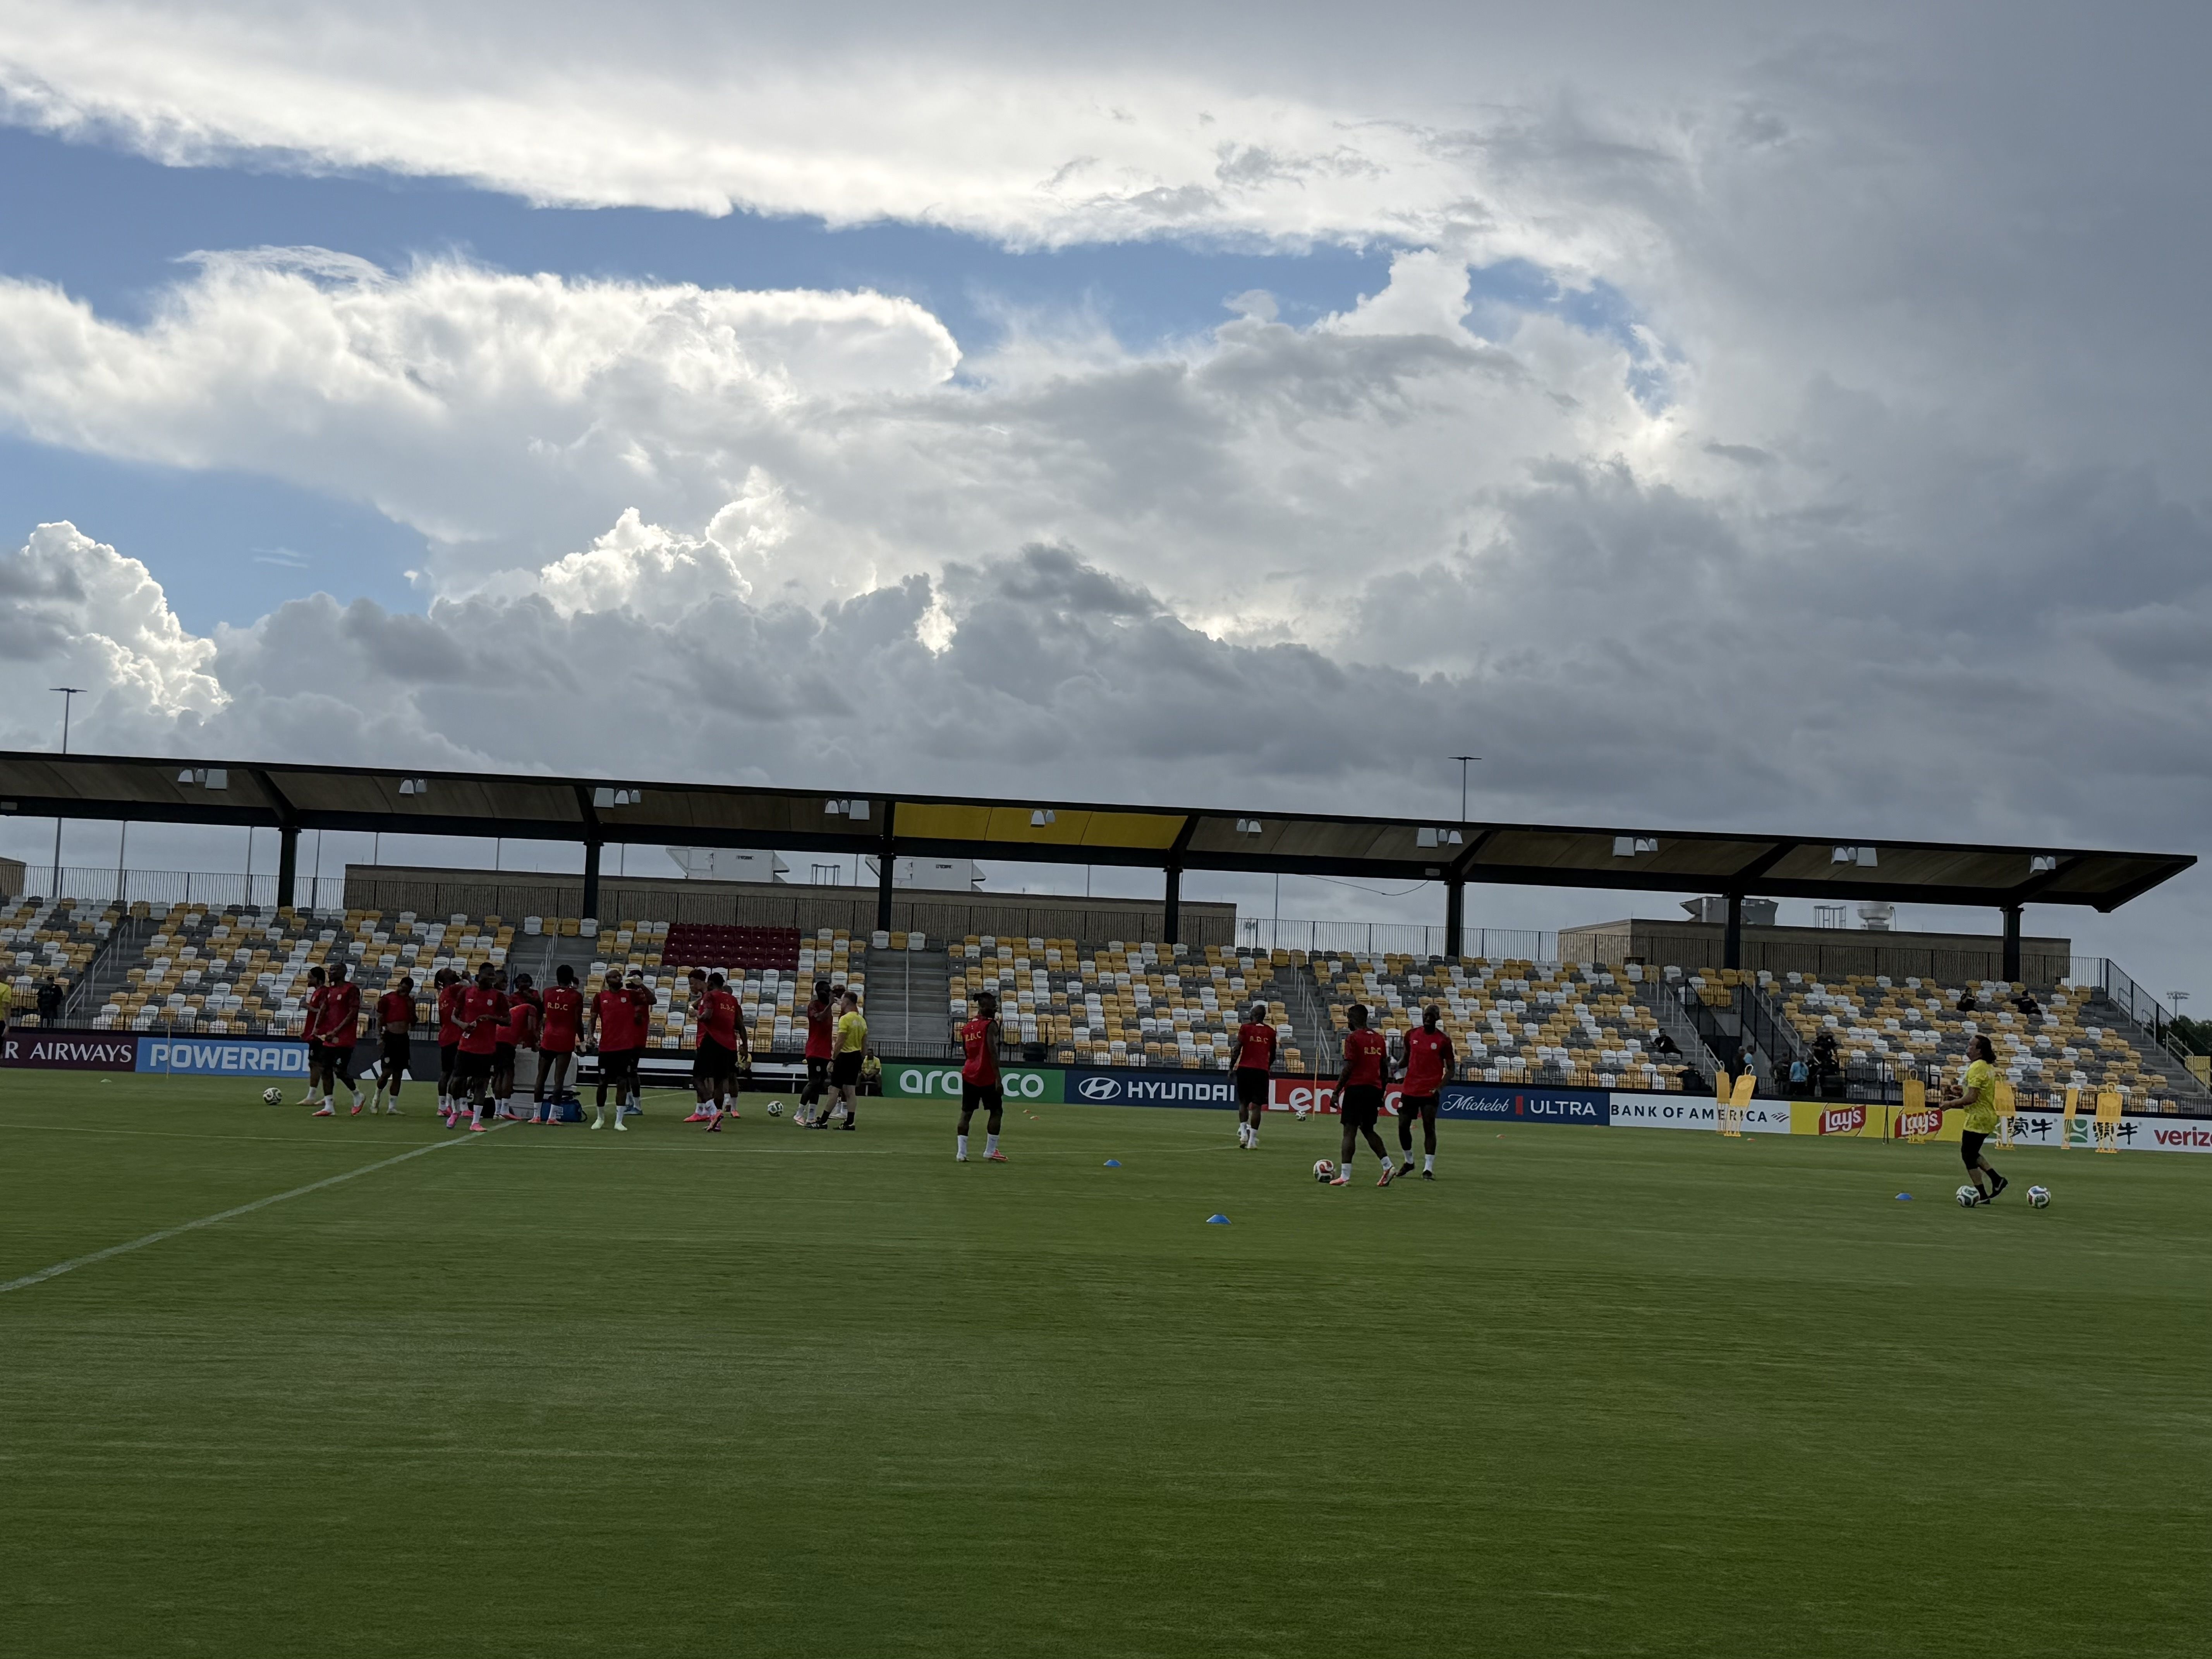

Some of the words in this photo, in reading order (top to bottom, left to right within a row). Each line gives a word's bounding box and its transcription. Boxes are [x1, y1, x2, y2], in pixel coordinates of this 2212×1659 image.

[1, 1041, 19, 1059] R
[29, 1042, 132, 1063] AIRWAYS
[900, 1070, 1044, 1098] araco
[1128, 1081, 1235, 1101] HYUNDAI
[1442, 1094, 1510, 1112] Michelob
[1530, 1099, 1597, 1116] ULTRA
[1611, 1104, 1657, 1117] BANK
[1663, 1107, 1684, 1118] OF
[1689, 1108, 1768, 1122] AMERICA
[1825, 1107, 1862, 1132] Lay's
[2154, 1126, 2212, 1147] veriz
